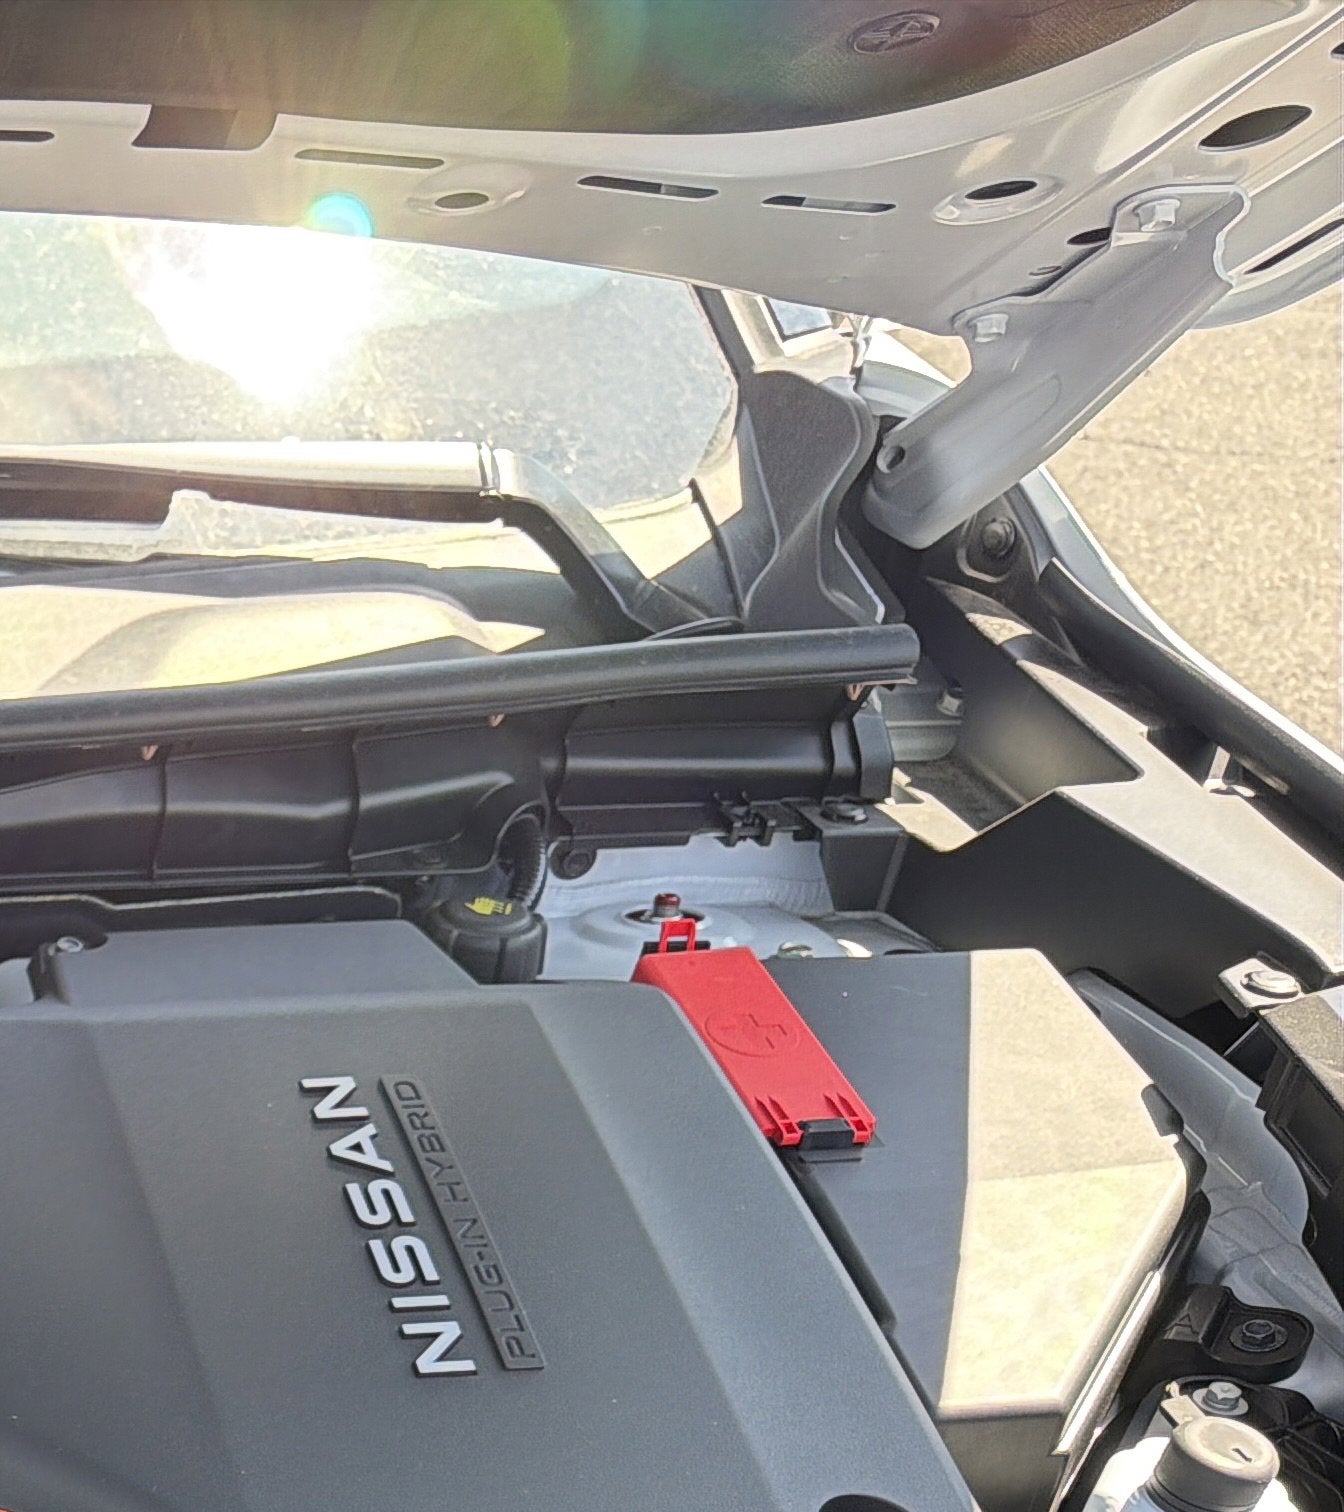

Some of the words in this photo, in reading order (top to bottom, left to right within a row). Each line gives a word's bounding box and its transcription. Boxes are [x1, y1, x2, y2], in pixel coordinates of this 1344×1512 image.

[393, 1079, 469, 1205] HYBRID
[298, 1076, 477, 1376] NISSAN
[453, 1216, 538, 1359] PLUG-IN
